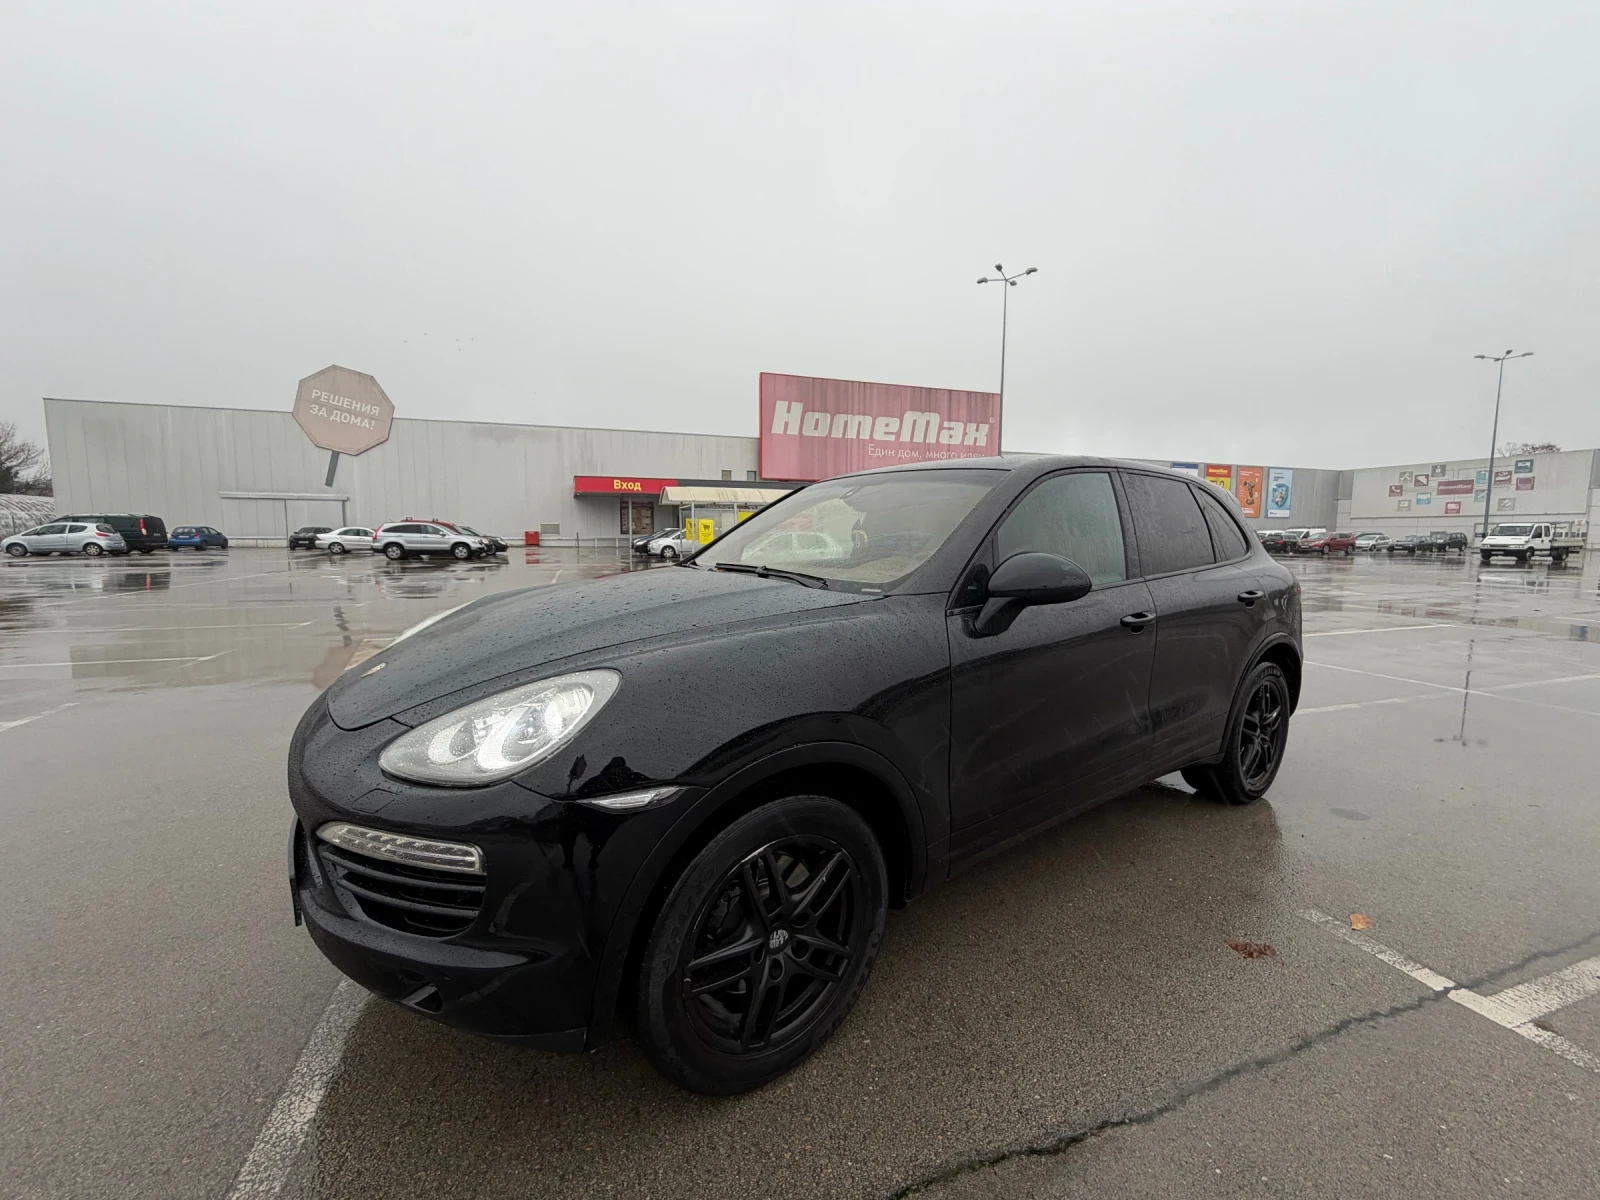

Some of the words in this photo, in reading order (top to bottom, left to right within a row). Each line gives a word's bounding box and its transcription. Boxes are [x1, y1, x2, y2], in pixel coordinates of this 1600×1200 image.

[311, 389, 380, 417] РЕШЕНИЯ
[310, 404, 328, 418] ЗА
[330, 409, 375, 430] ДОМА!
[771, 400, 990, 447] HomeMax
[868, 444, 895, 458] Един
[897, 450, 922, 460] дом,
[925, 450, 958, 460] много
[613, 480, 642, 492] Вход
